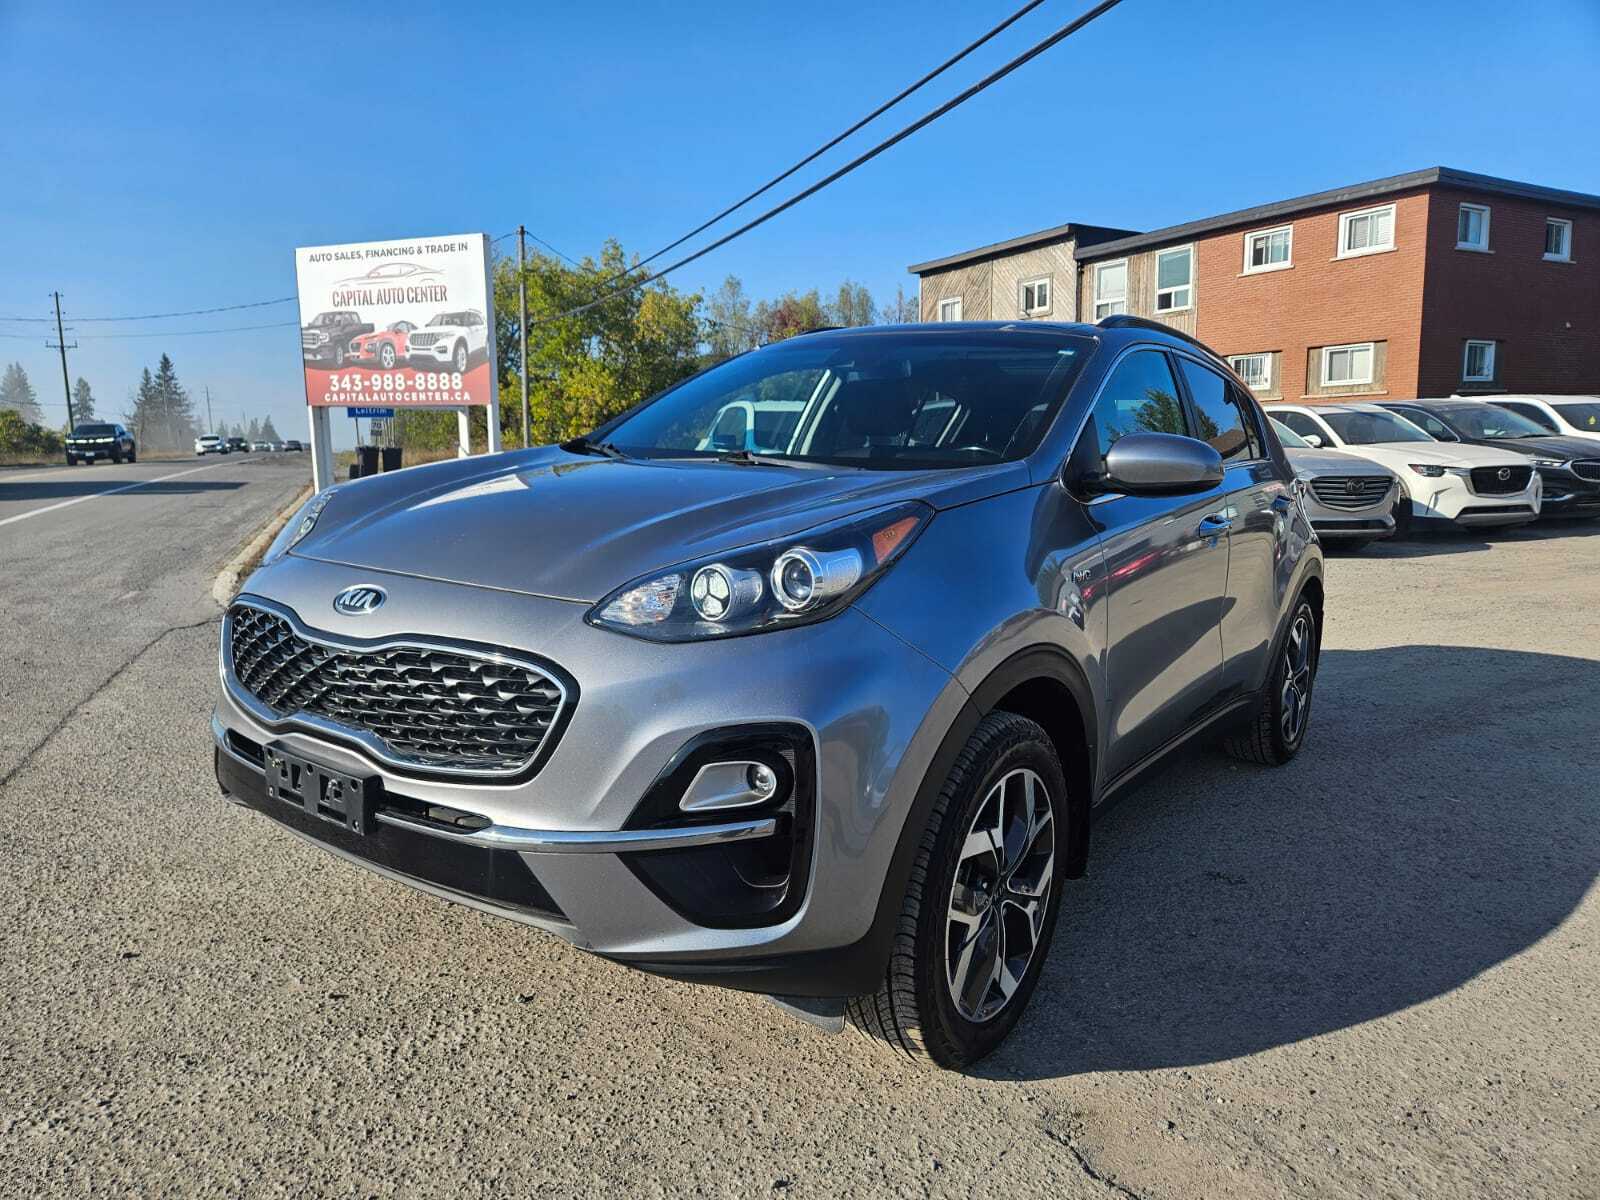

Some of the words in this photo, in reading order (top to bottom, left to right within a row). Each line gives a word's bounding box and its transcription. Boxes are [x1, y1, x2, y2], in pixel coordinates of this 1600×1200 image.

[309, 253, 333, 262] AUTO
[334, 251, 364, 261] SALES,
[365, 246, 415, 257] FINANCING
[416, 246, 423, 255] &
[424, 243, 456, 254] TRADE
[458, 242, 468, 251] IN
[332, 289, 375, 307] CAPITAL
[376, 287, 405, 304] AUTO
[406, 285, 448, 302] CENTER
[329, 373, 463, 391] 343-988-8888
[324, 391, 471, 402] CAPITALAUTOCENTER.CA
[339, 590, 376, 609] KIA
